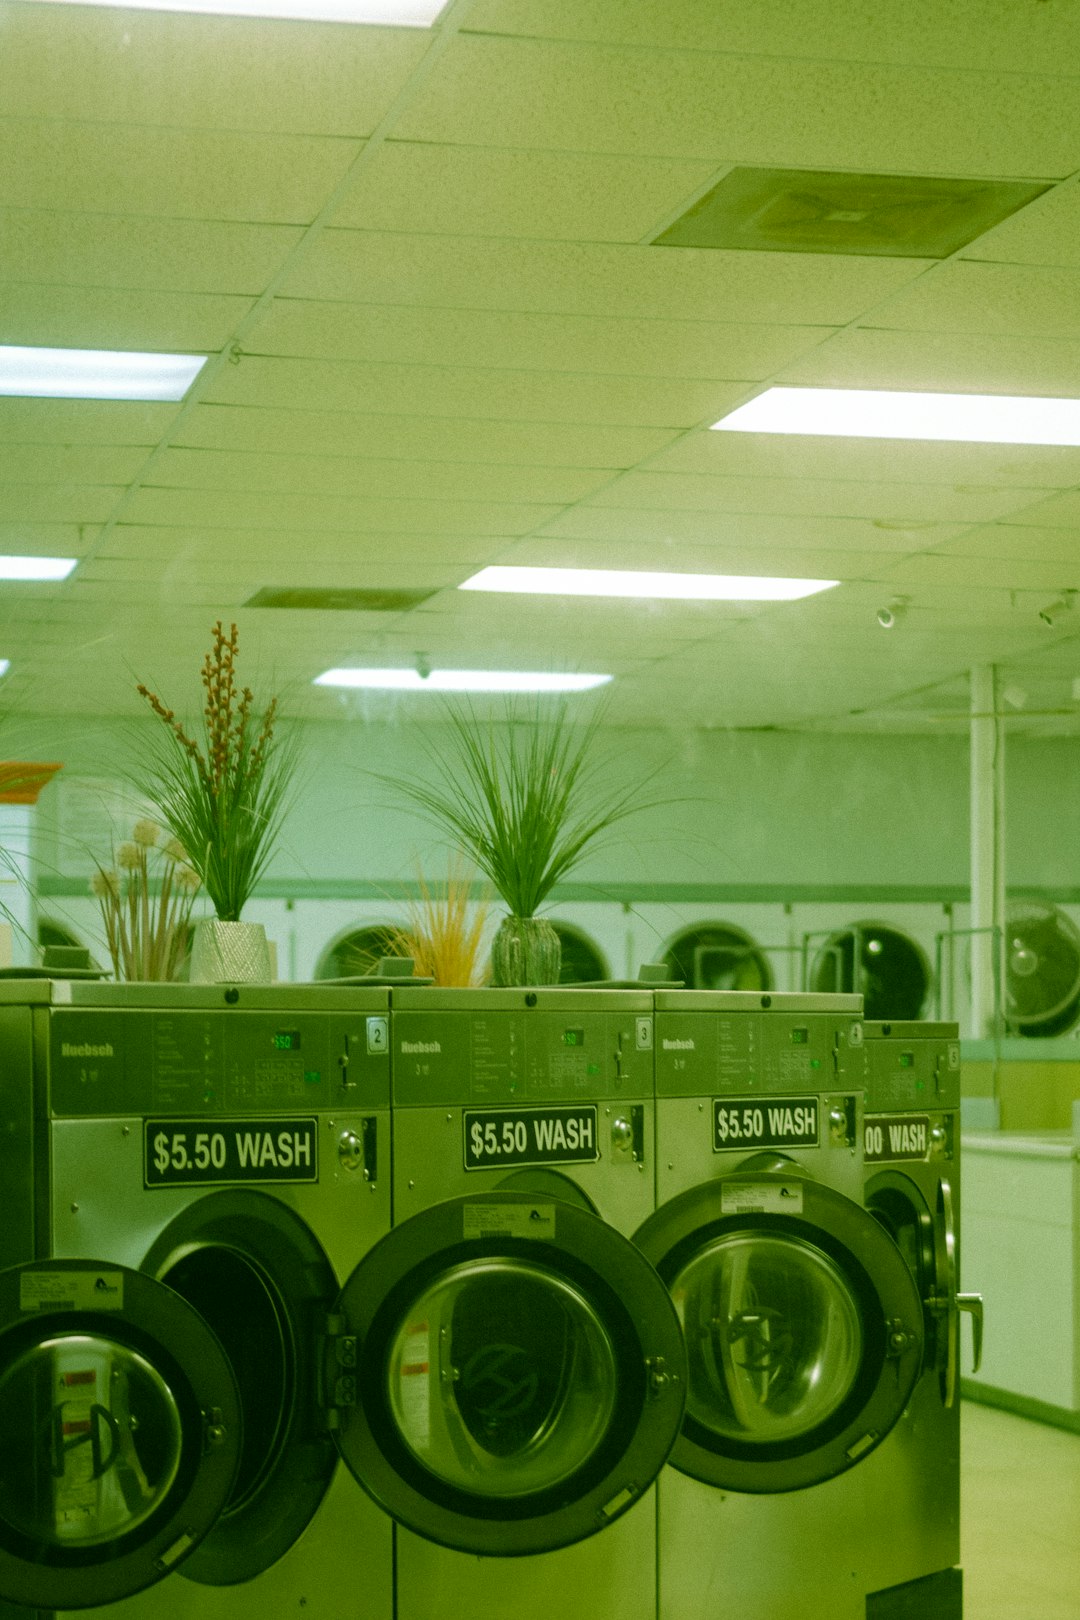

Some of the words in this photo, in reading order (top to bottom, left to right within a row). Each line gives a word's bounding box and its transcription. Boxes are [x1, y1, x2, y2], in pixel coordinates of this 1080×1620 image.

[373, 1029, 382, 1043] 2
[642, 1027, 649, 1041] 3
[471, 1121, 527, 1159] $5.50
[534, 1118, 592, 1151] WASH
[718, 1108, 763, 1142] $5.50
[768, 1107, 816, 1136] WASH
[888, 1124, 926, 1152] WASH
[153, 1131, 227, 1174] $5.50
[236, 1131, 311, 1169] WASH
